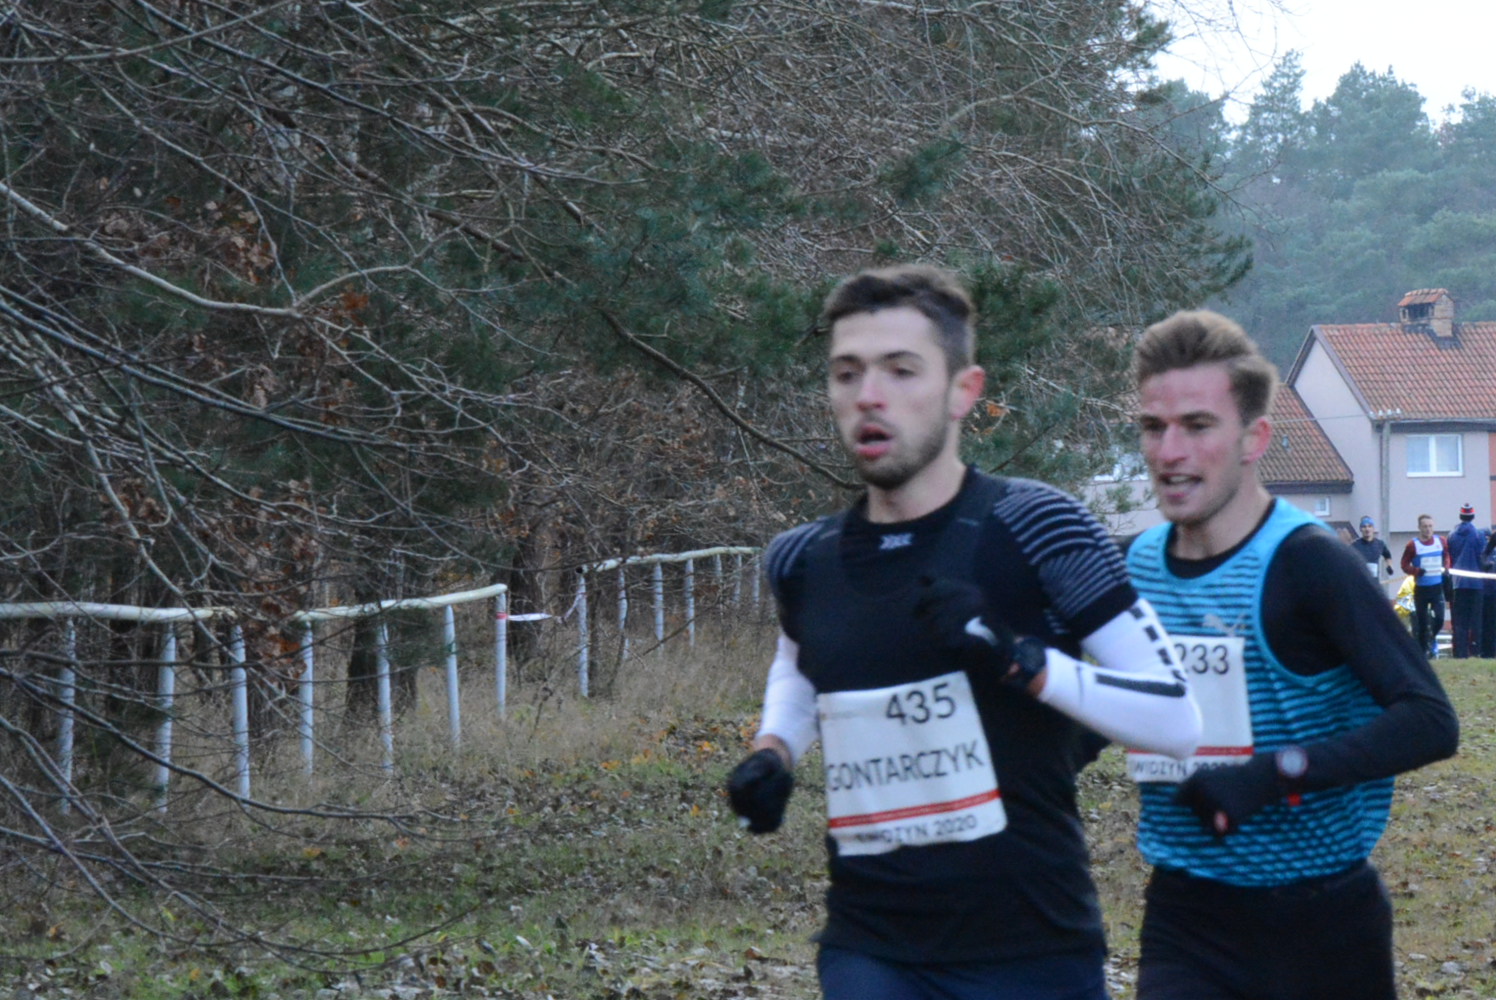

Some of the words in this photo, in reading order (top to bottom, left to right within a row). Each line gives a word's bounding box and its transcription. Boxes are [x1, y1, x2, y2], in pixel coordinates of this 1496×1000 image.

[1173, 642, 1230, 676] 233
[886, 682, 957, 725] 435
[827, 741, 985, 792] GONTARCZYK
[934, 814, 978, 837] 2020
